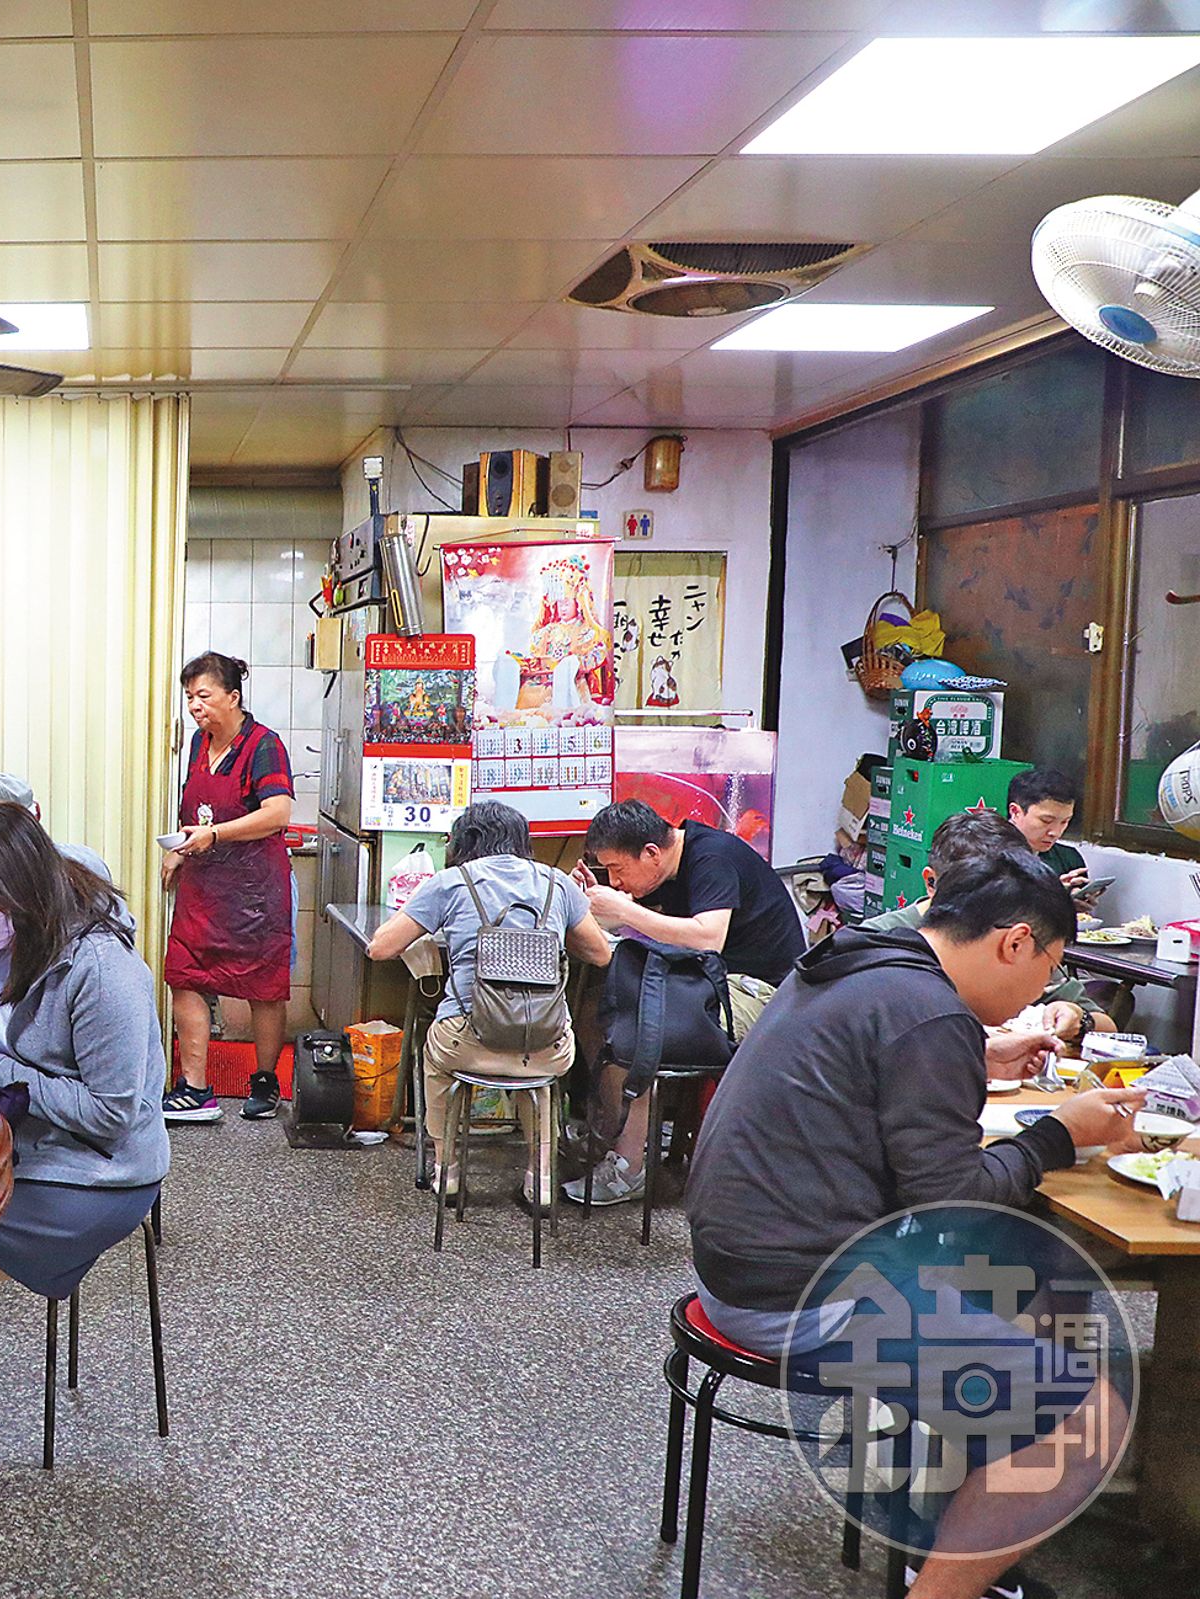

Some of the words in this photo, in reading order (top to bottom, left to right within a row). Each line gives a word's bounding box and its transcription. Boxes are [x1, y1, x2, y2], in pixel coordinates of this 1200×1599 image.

[683, 585, 707, 631] ニャン
[647, 594, 672, 647] 幸せ
[513, 738, 522, 754] 3
[567, 735, 576, 752] 5
[593, 736, 601, 750] 6
[566, 766, 577, 780] 11
[404, 806, 432, 823] 30
[892, 823, 923, 842] Heineken
